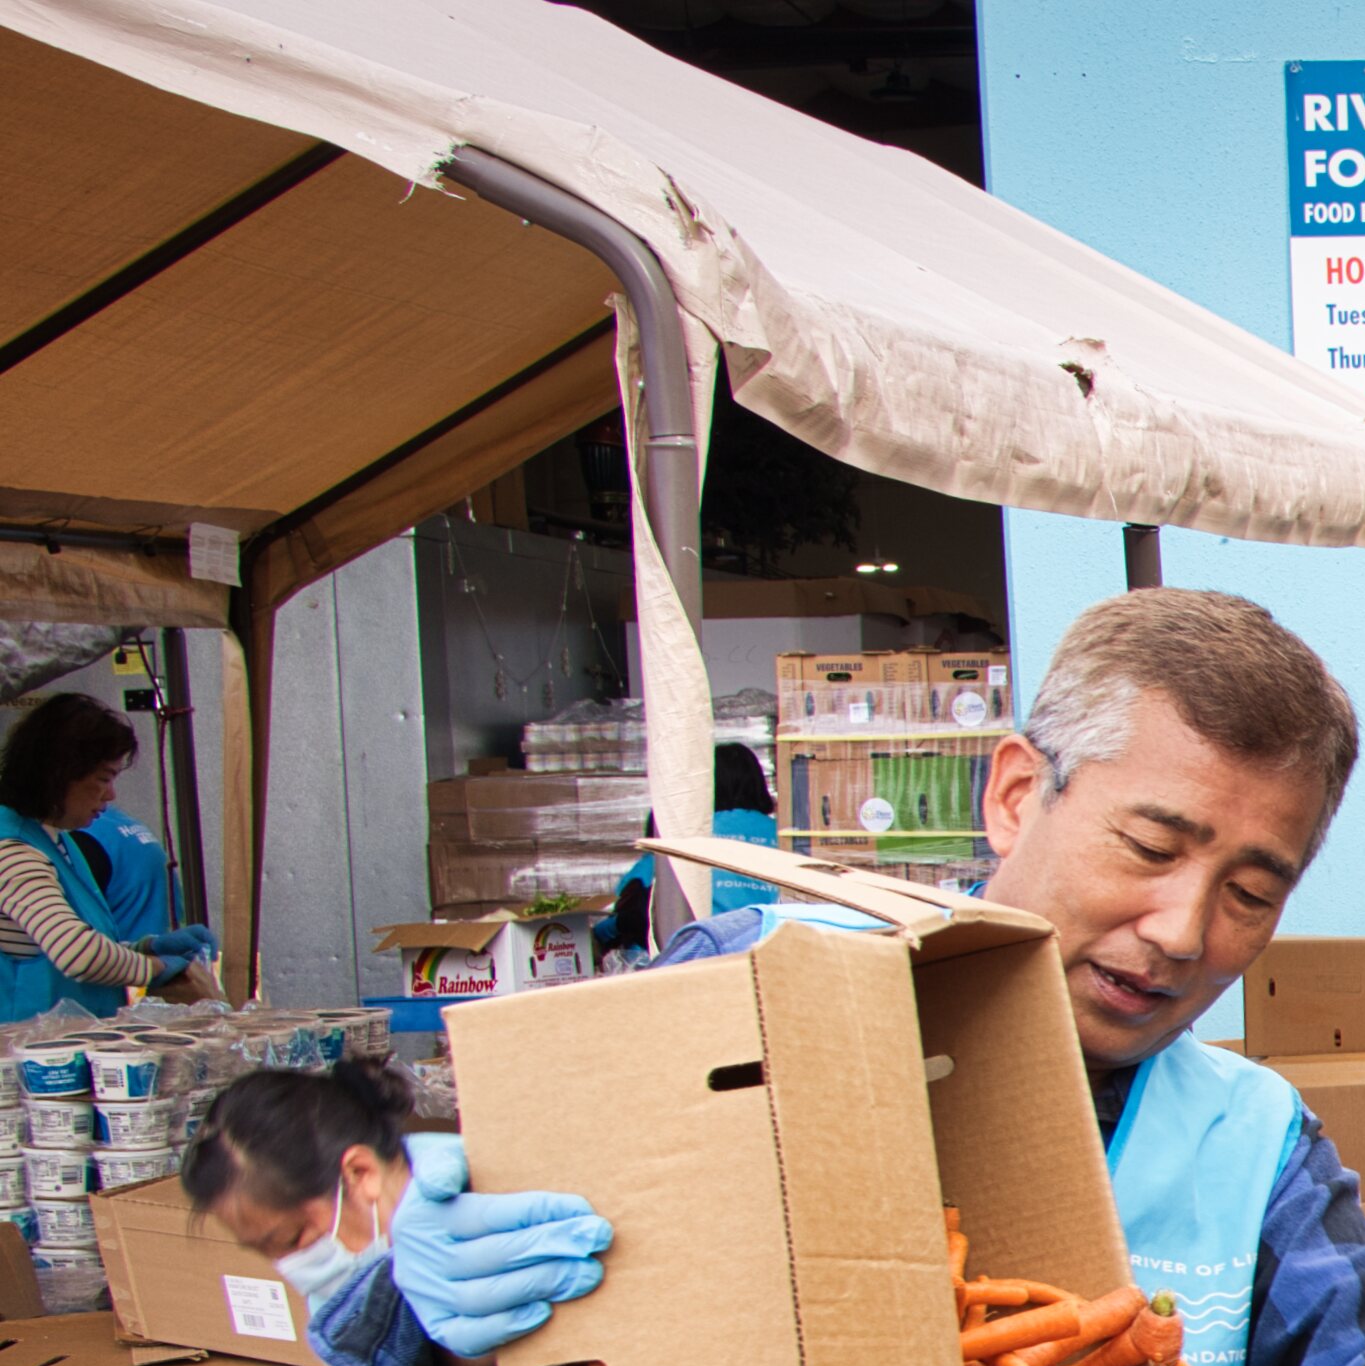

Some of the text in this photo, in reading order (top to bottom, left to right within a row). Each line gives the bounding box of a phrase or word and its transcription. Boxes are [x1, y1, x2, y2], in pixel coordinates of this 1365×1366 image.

[1304, 202, 1355, 224] FOOD
[816, 662, 863, 673] VEGETABLES
[941, 659, 989, 669] VEGETABLES
[716, 880, 778, 892] FOUNDAT
[547, 942, 577, 953] Rainbow
[438, 973, 498, 995] Rainbow
[1130, 1252, 1189, 1276] RIVER
[1196, 1259, 1225, 1276] OF
[1180, 1347, 1248, 1364] NDATIO
